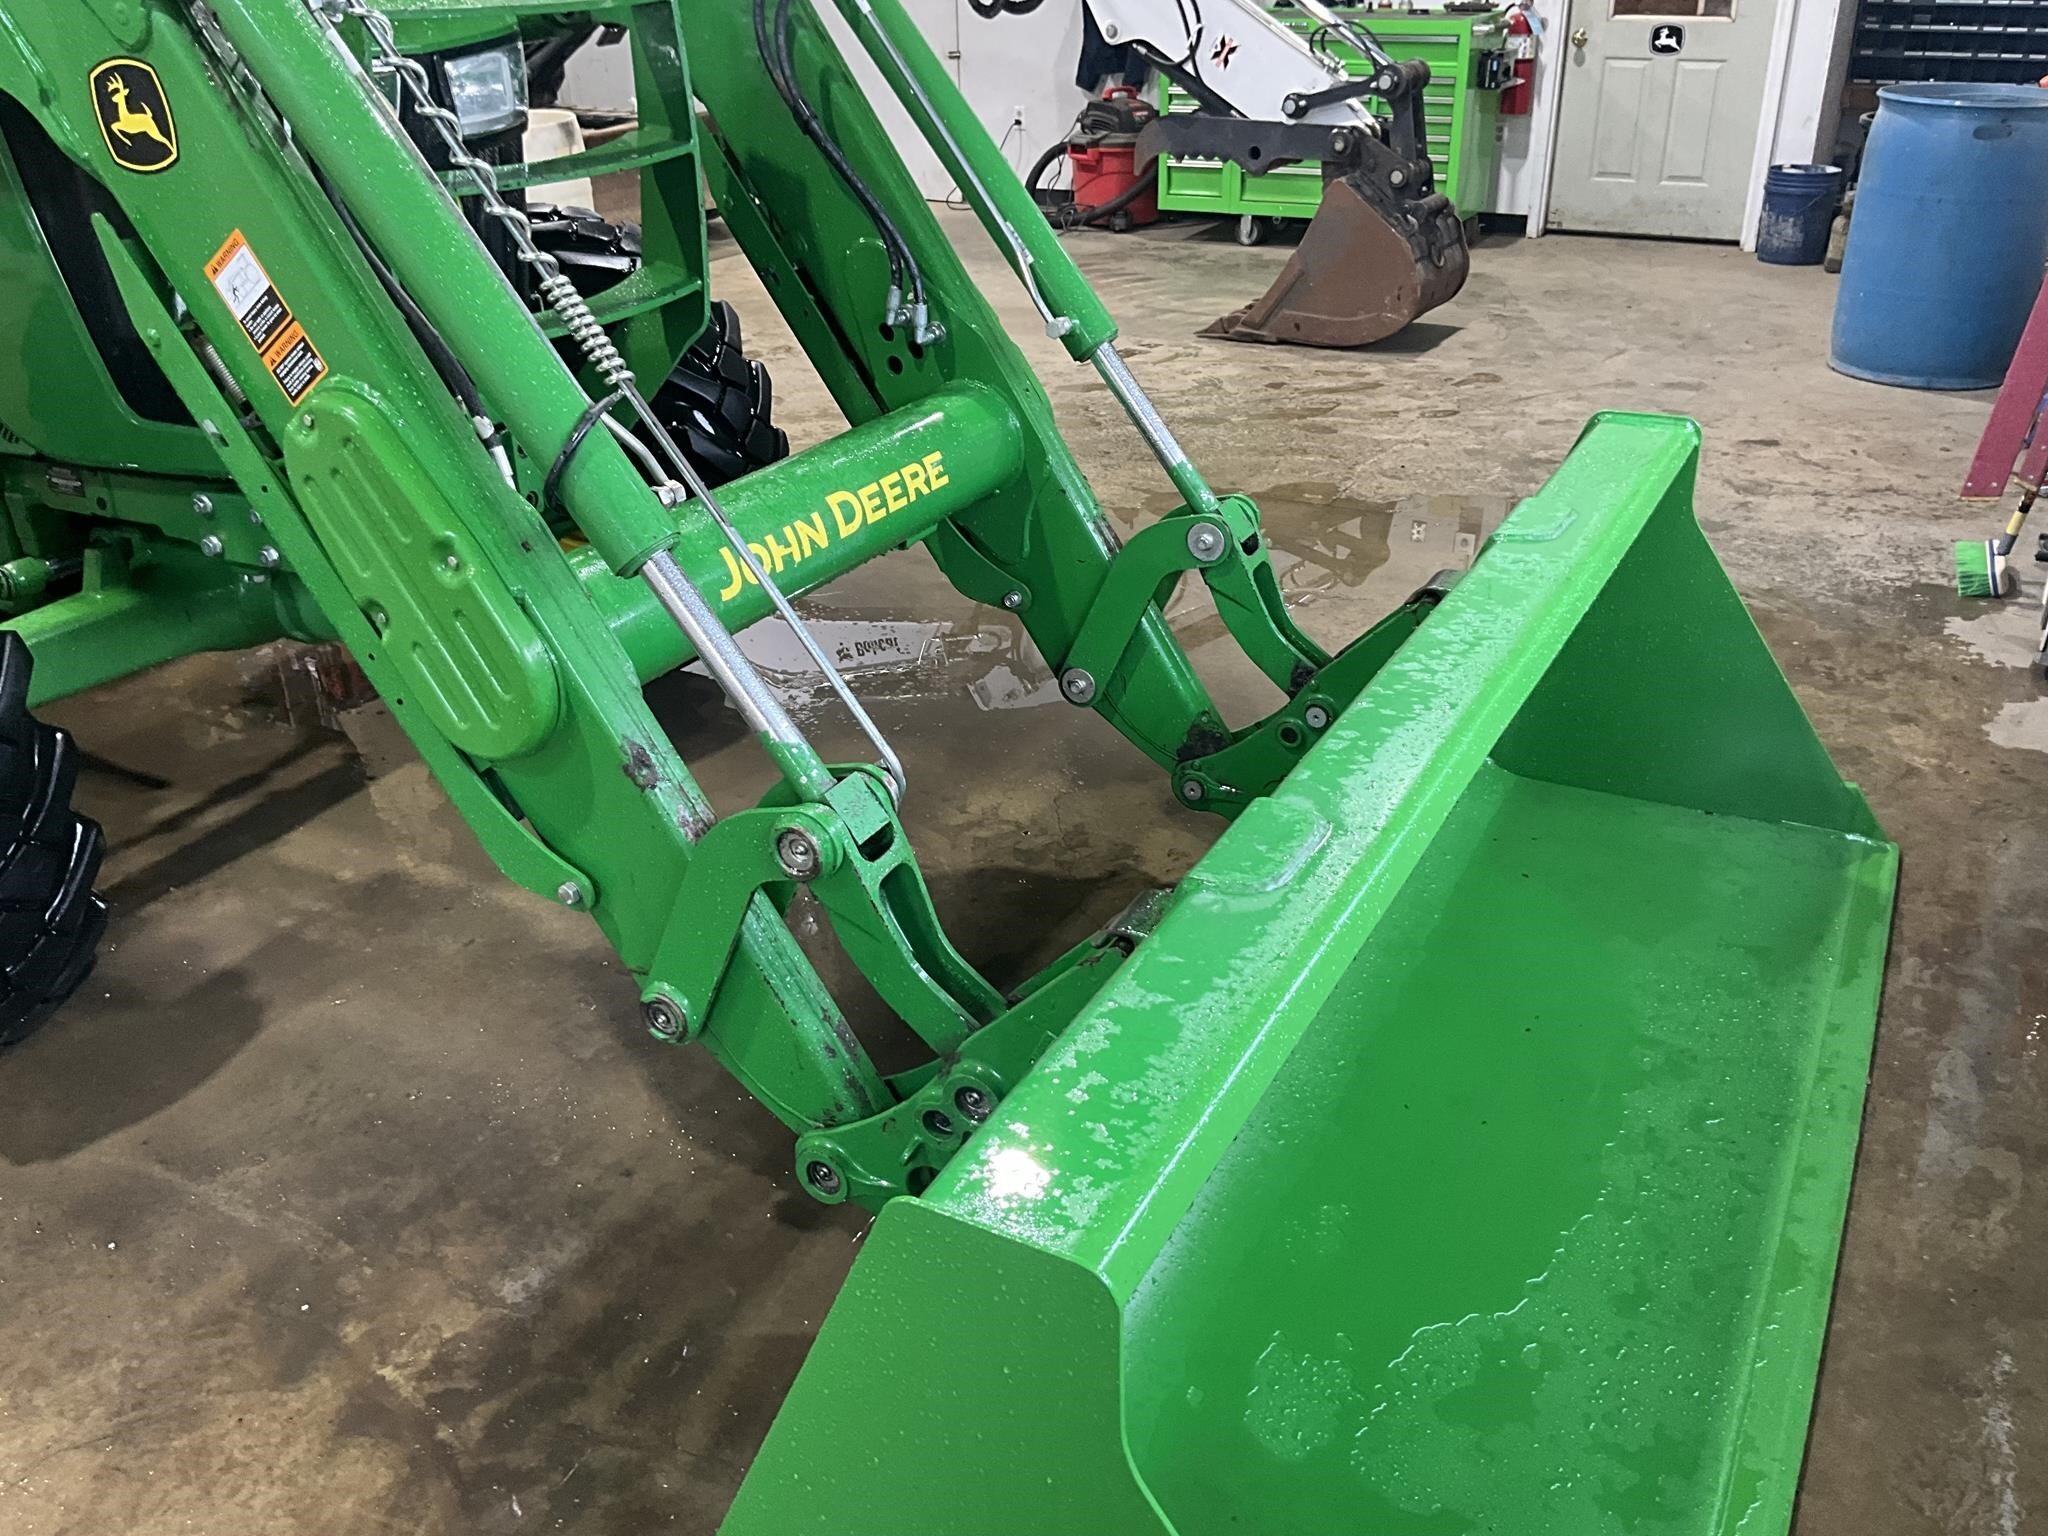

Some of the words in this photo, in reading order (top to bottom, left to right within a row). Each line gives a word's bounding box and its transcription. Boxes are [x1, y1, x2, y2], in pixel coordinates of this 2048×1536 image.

[216, 237, 240, 268] WARNING
[275, 329, 300, 358] WARNING
[719, 511, 829, 602] JOHN
[825, 450, 949, 539] DEERE
